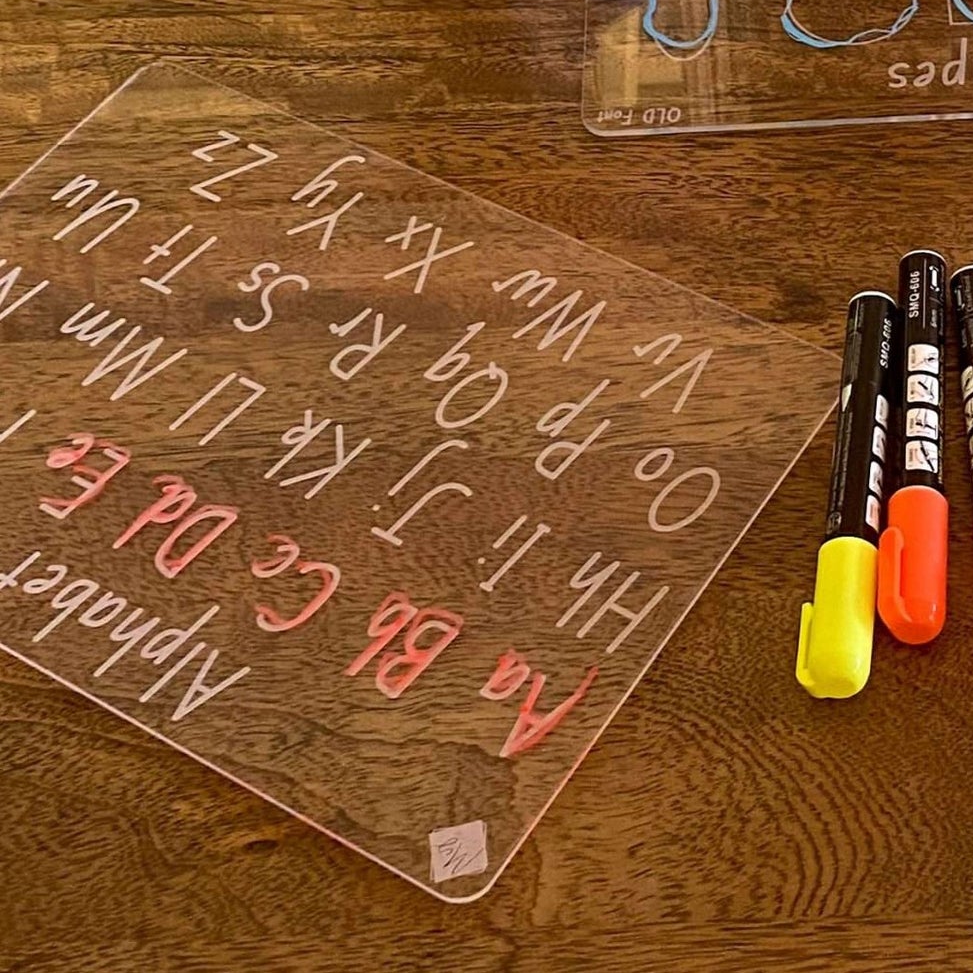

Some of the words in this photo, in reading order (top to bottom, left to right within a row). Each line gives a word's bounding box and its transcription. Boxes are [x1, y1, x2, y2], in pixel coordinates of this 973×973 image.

[596, 108, 634, 126] Font
[189, 129, 280, 203] Zz
[286, 154, 367, 252] Yy
[50, 173, 141, 255] Uu
[139, 223, 219, 296] Tt
[383, 214, 475, 296] Xx
[231, 261, 311, 333] Ss
[491, 269, 608, 363] Ww
[908, 270, 922, 319] SMQ-606
[60, 302, 189, 402] Mm
[328, 307, 407, 382] Rr
[422, 320, 509, 429] Qq
[37, 432, 133, 521] Ee
[263, 409, 372, 501] Kk
[535, 378, 613, 482] Pp
[111, 474, 242, 580] Dd
[371, 438, 475, 547] Jj
[0, 550, 252, 722] Alphabet
[343, 590, 466, 701] Bb
[554, 551, 671, 655] Hh
[478, 647, 601, 760] Aa
